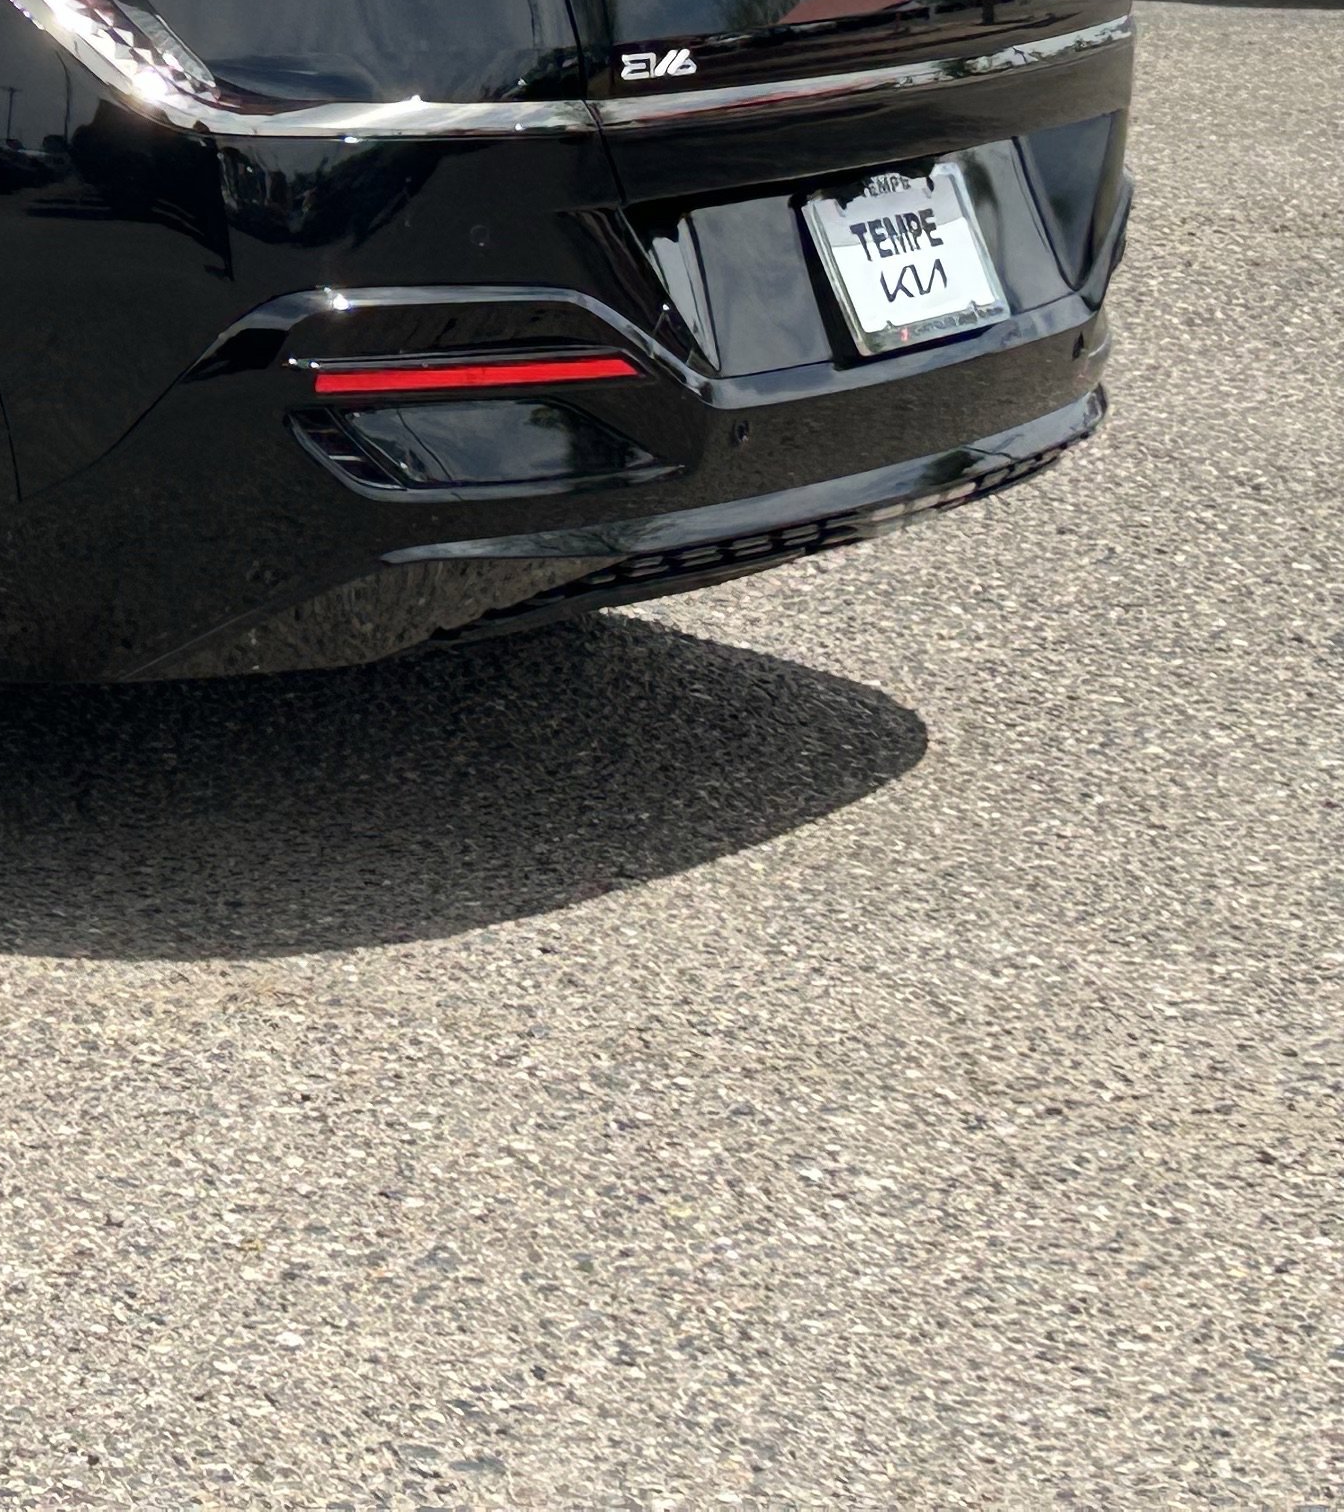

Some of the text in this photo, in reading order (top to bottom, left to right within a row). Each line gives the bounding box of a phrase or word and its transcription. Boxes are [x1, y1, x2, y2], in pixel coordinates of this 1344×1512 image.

[621, 48, 697, 80] EV6
[864, 175, 912, 197] EMPE
[849, 208, 944, 261] TEMPE
[880, 258, 947, 302] KIA
